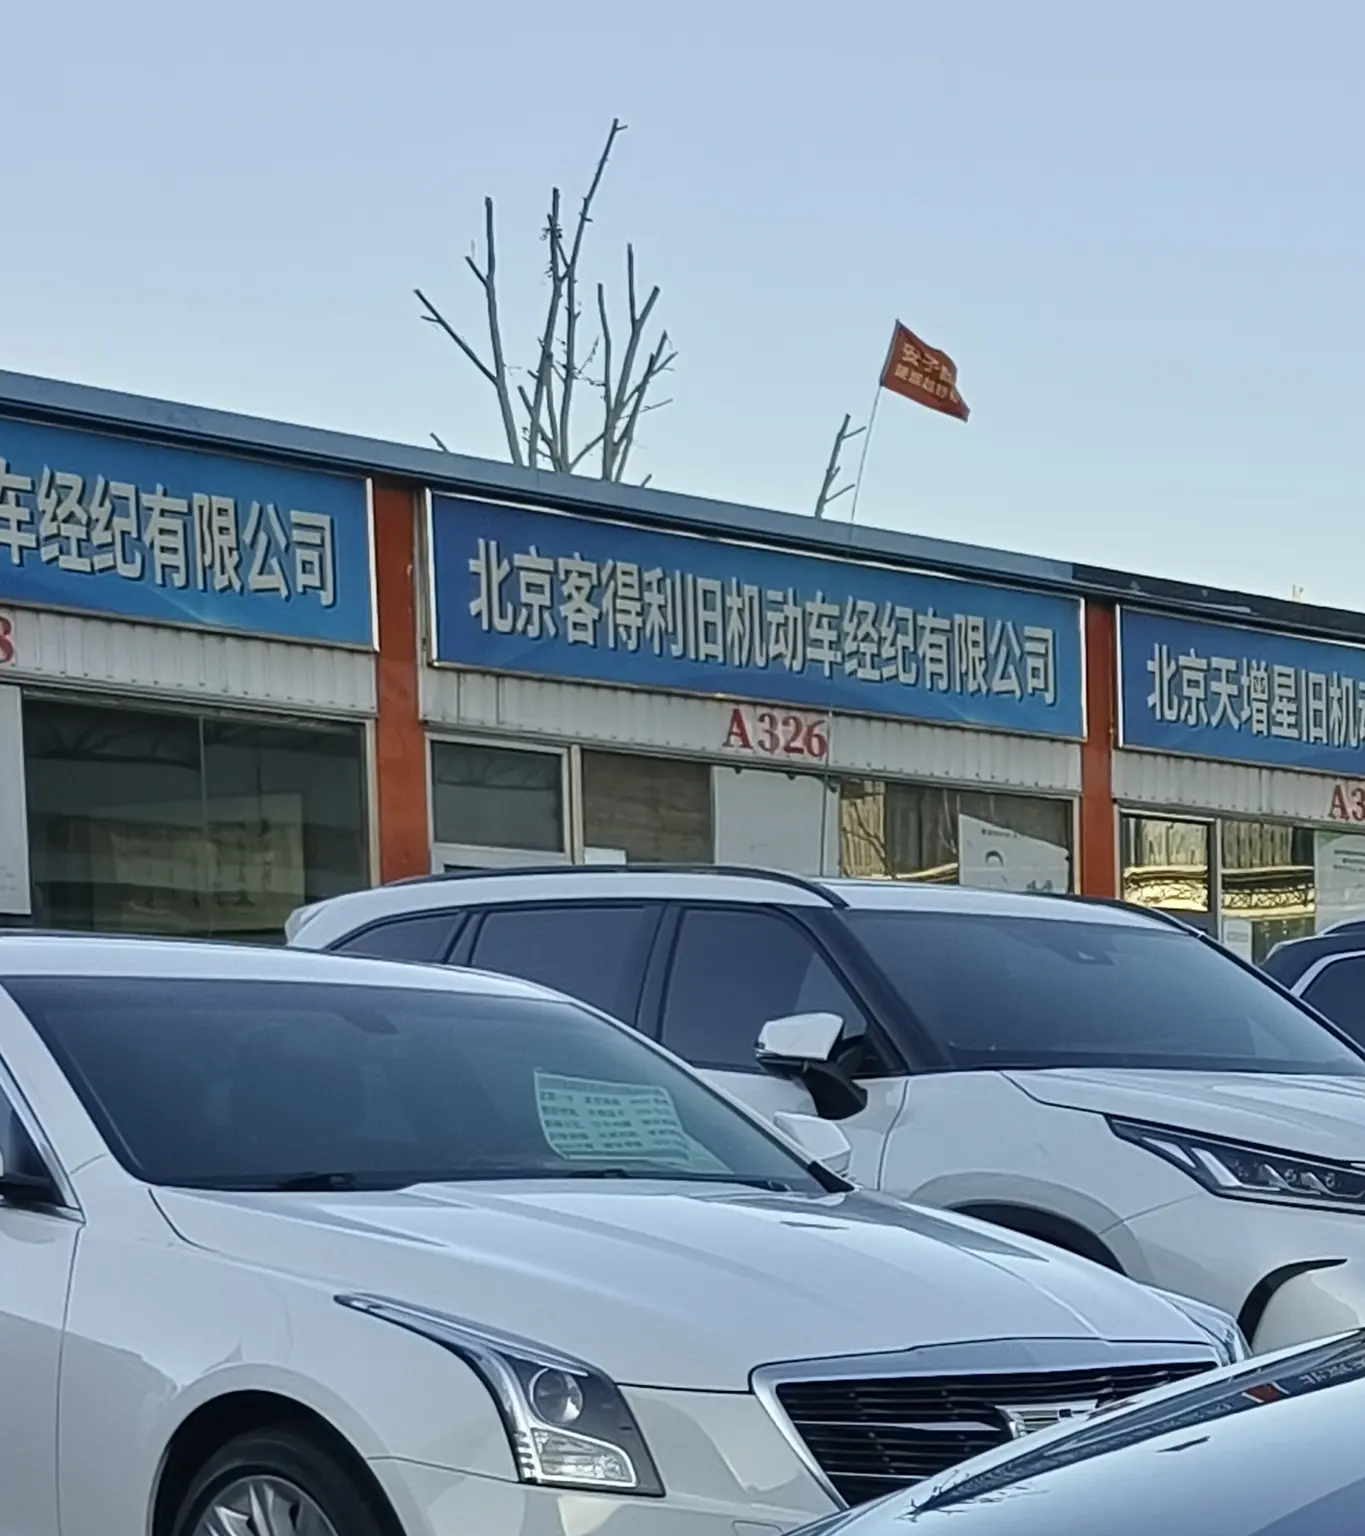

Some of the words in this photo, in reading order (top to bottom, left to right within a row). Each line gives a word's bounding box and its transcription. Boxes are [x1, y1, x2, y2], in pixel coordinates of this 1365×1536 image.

[469, 538, 1055, 703] 北京客得利旧机动车经纪有限公司
[722, 708, 828, 757] A326
